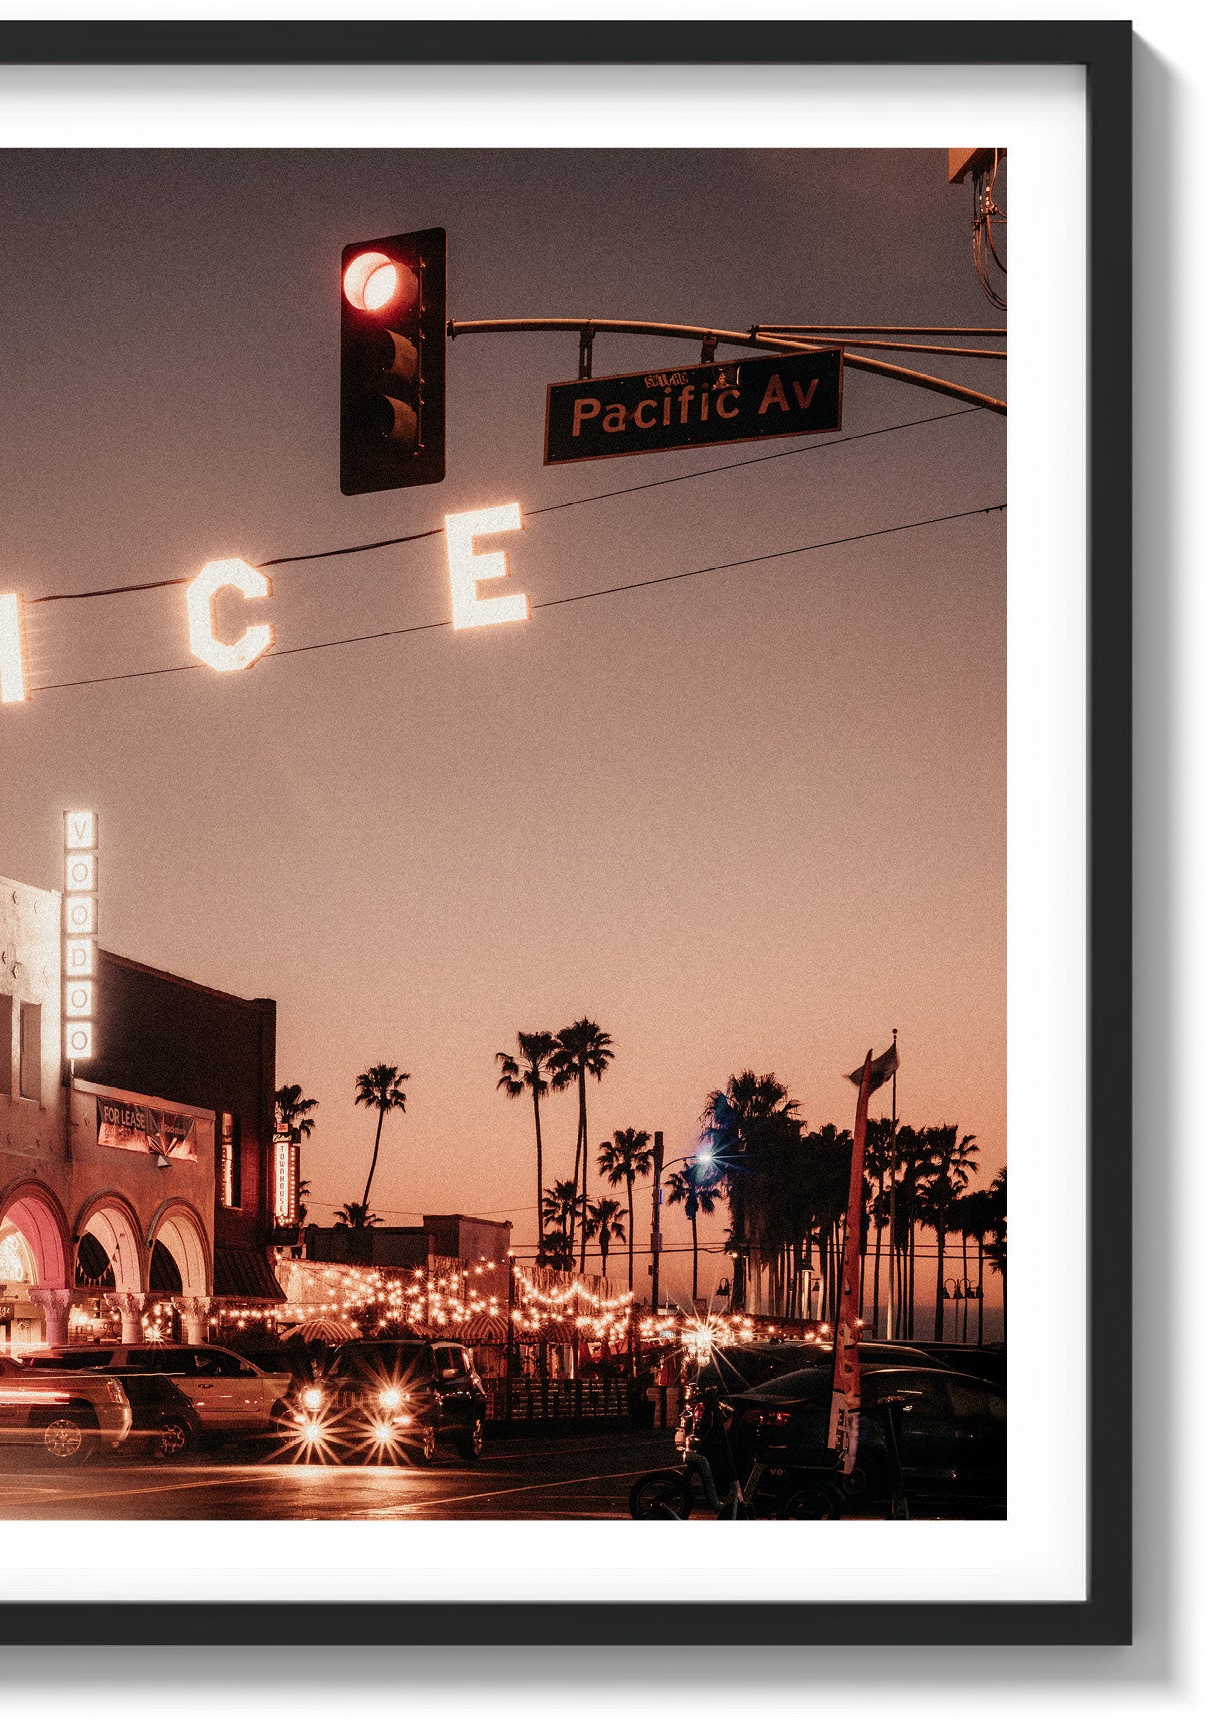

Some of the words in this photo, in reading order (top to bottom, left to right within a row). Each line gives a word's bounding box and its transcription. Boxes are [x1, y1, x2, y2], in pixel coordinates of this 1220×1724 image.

[572, 382, 741, 437] Pacific
[757, 373, 820, 415] Av
[70, 818, 89, 1052] VOODOO
[103, 1105, 120, 1126] FOR
[121, 1109, 146, 1130] LEASE
